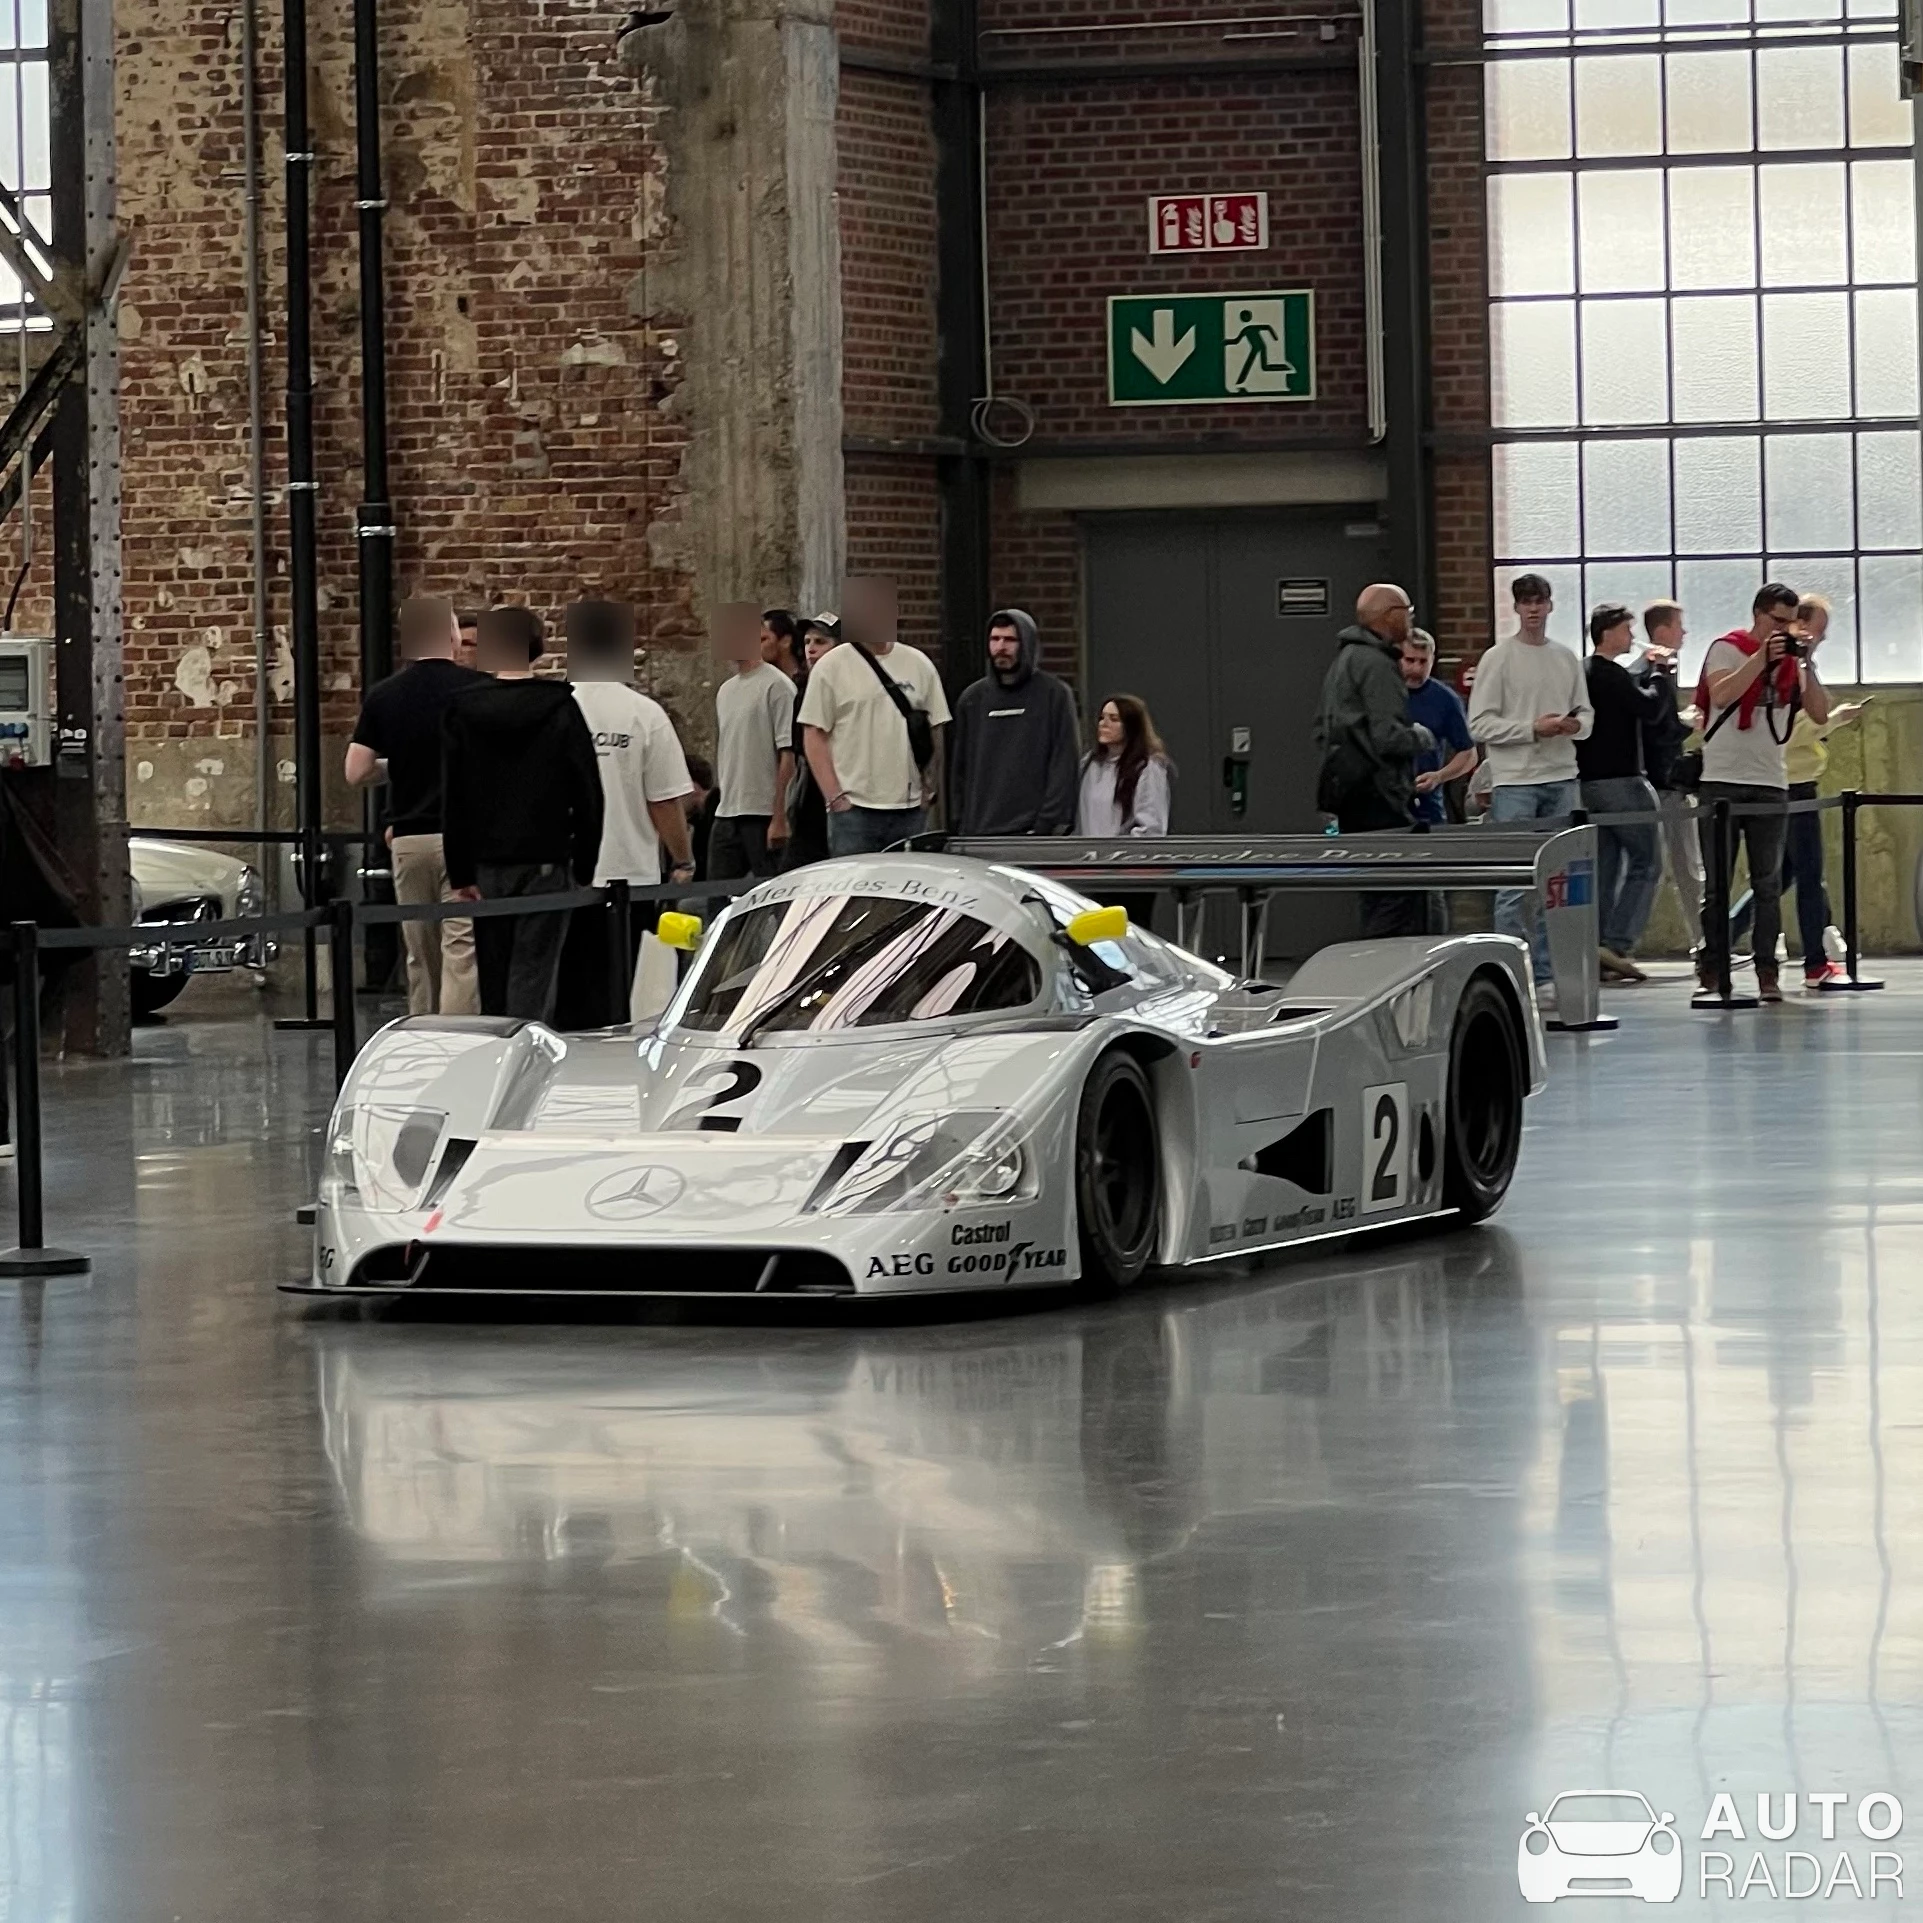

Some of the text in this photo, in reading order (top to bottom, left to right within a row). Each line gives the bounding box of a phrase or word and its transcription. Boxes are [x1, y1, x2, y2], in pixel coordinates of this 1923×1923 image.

[747, 879, 979, 910] Mercedes-Benz
[659, 1060, 762, 1132] 2
[1371, 1093, 1399, 1201] 2
[951, 1220, 1011, 1246] Castrol
[866, 1253, 934, 1278] AEG
